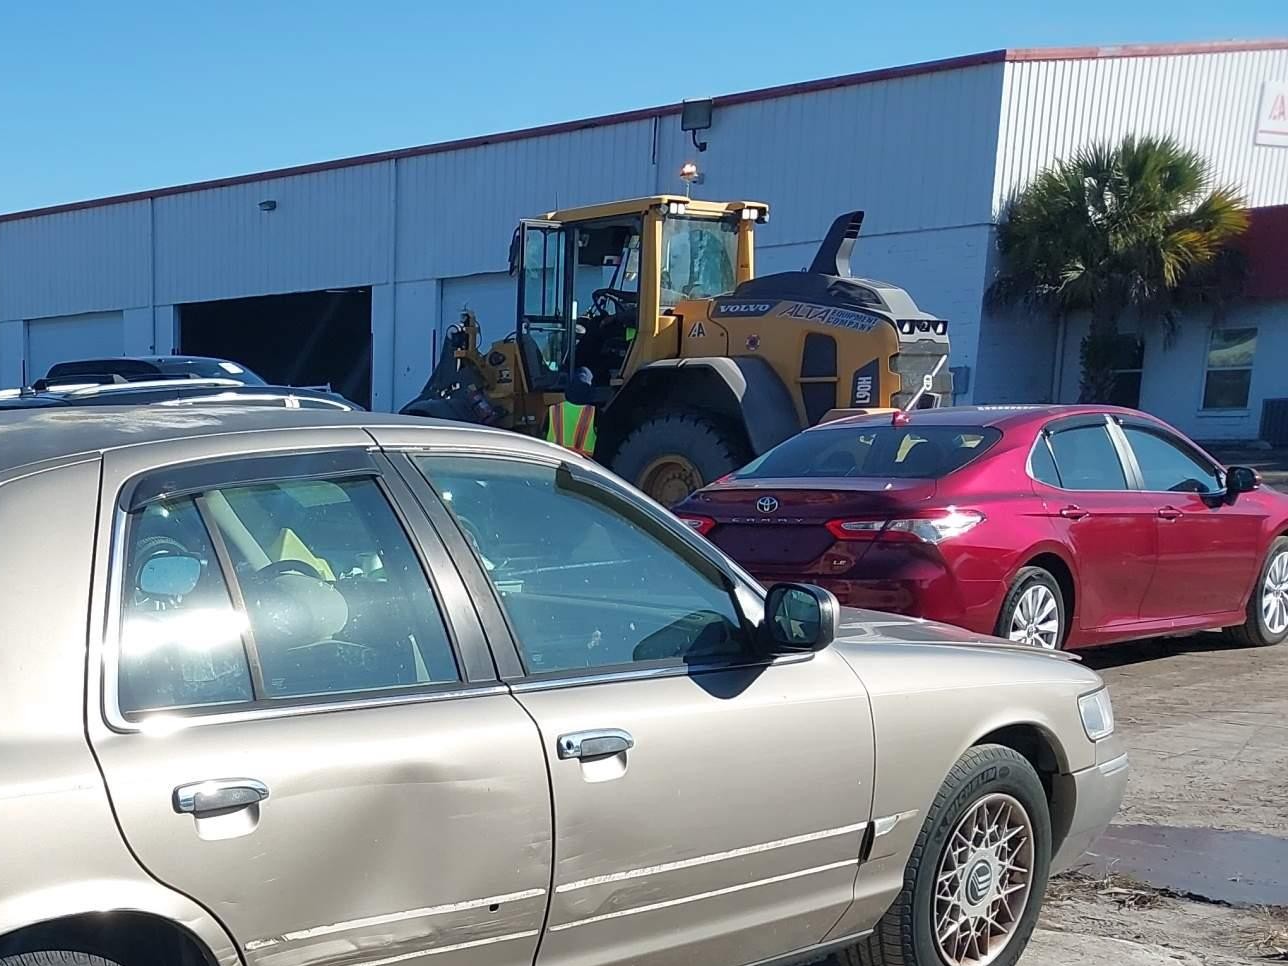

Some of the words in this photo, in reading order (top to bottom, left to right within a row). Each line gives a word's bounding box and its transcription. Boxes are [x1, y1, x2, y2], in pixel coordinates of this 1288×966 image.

[719, 303, 769, 313] VOLVO
[778, 303, 829, 323] ALTA
[826, 317, 873, 333] COMPANY
[829, 309, 879, 327] EQUIPMENT
[855, 376, 872, 404] L90H
